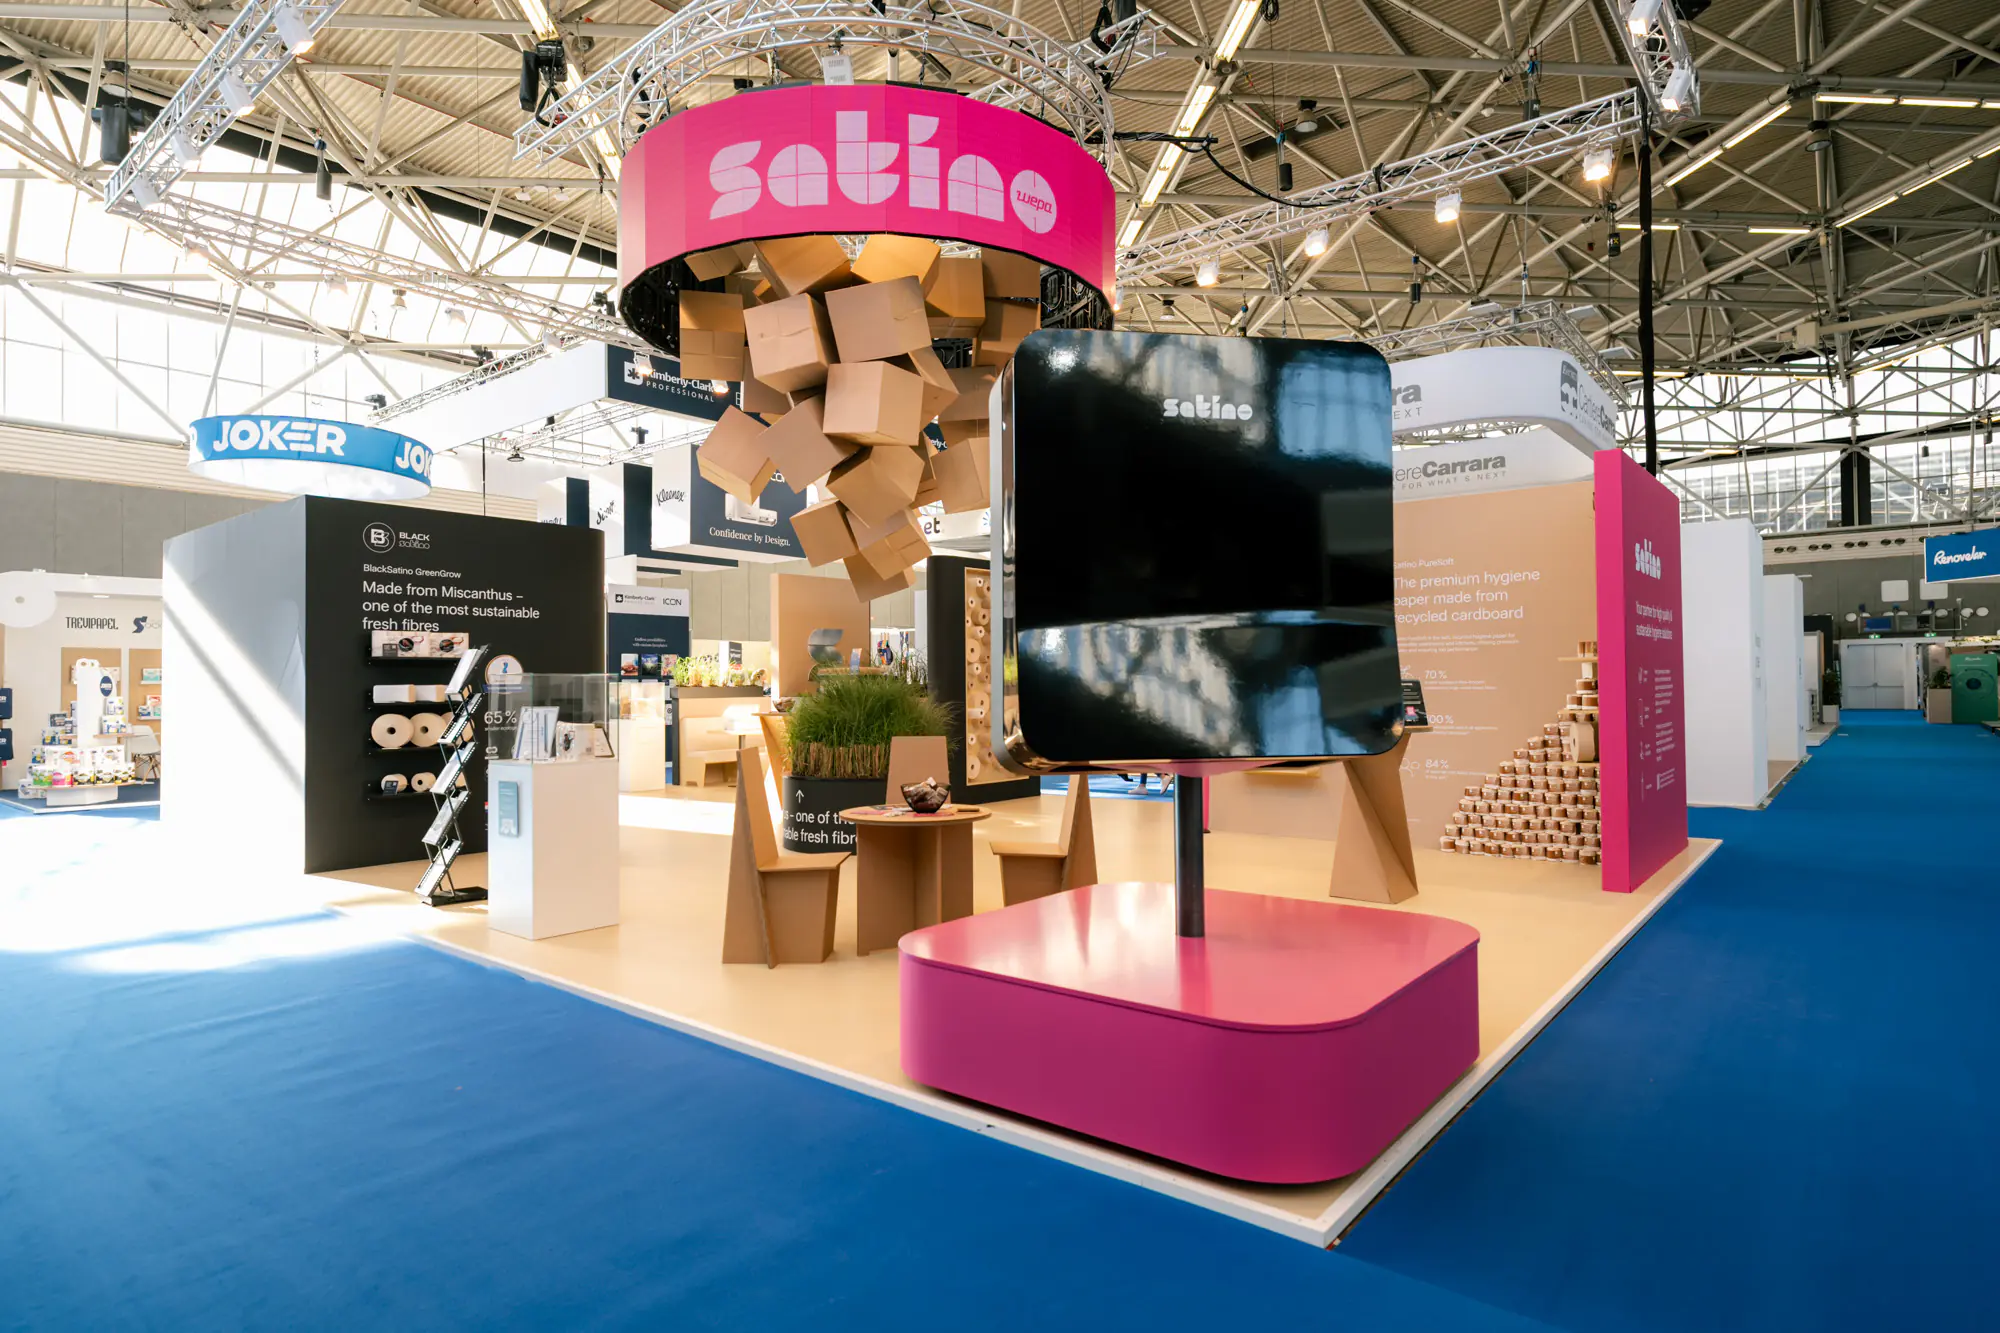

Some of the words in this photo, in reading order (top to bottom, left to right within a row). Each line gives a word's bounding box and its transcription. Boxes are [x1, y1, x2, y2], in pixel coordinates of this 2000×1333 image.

[709, 110, 1058, 234] satino
[1016, 189, 1053, 214] wepa
[648, 368, 714, 392] imberly-Clark
[646, 380, 715, 402] PROFESSIONAL
[1163, 394, 1253, 420] satino
[213, 419, 347, 456] JOKER
[1477, 470, 1506, 480] NEXT
[399, 531, 430, 542] BLACK
[709, 526, 753, 541] Confidence
[754, 532, 764, 544] by
[764, 534, 791, 547] Design.
[363, 563, 414, 575] BlackSatino
[415, 567, 462, 579] GreenGrow
[1420, 573, 1480, 590] premium
[1484, 569, 1541, 586] hygiene
[363, 580, 403, 595] Made
[405, 583, 438, 597] from
[441, 585, 513, 601] Miscanthus
[1433, 590, 1472, 605] made
[1475, 589, 1509, 602] from
[663, 598, 682, 606] ICON
[362, 601, 390, 613] one
[393, 601, 408, 614] of
[411, 602, 433, 615] the
[436, 605, 469, 617] most
[472, 606, 540, 620] sustainable
[1451, 606, 1524, 622] cardboard
[65, 616, 119, 630] TREVIPAPEL
[362, 617, 398, 631] fresh
[402, 619, 440, 632] fibres
[1425, 670, 1437, 679] 70
[484, 711, 503, 725] 65
[505, 711, 517, 724] %
[1427, 714, 1444, 724] 00
[796, 812, 814, 823] one
[818, 811, 830, 824] of
[800, 829, 828, 843] fresh
